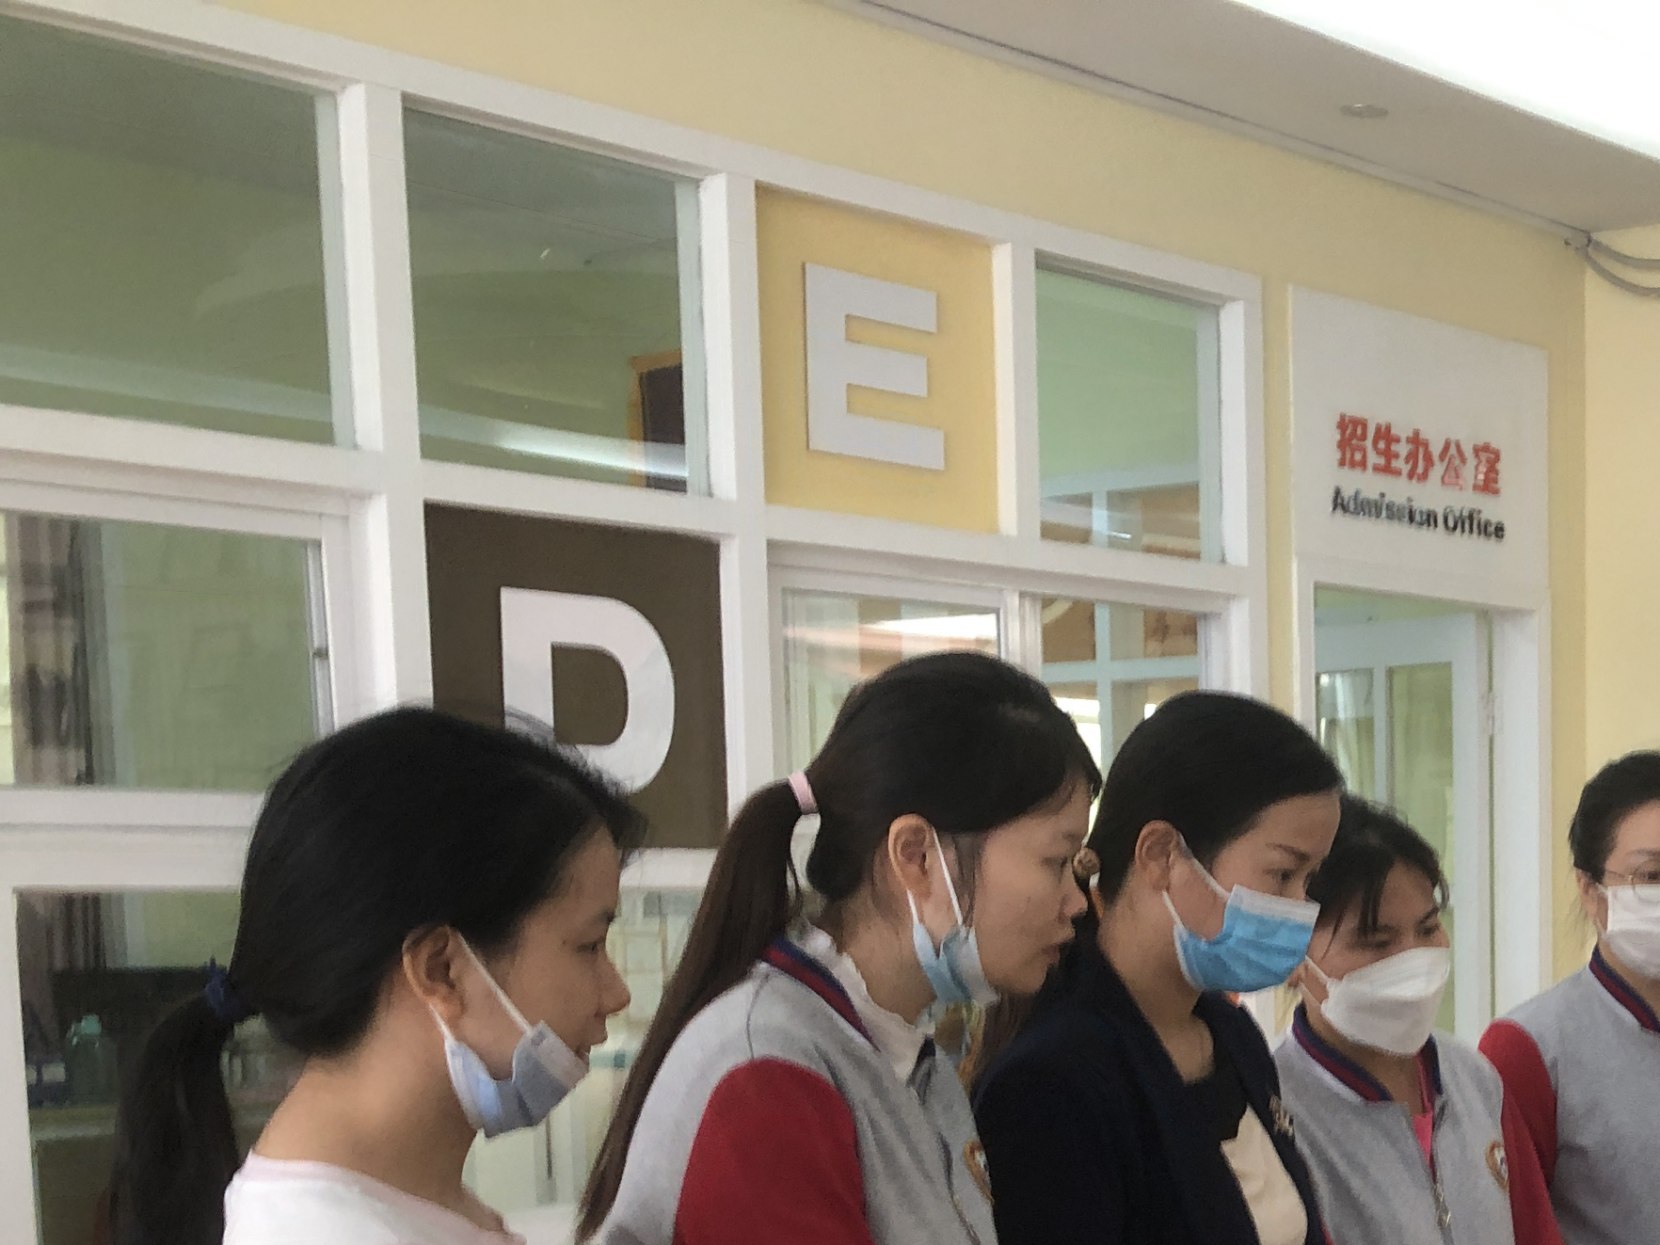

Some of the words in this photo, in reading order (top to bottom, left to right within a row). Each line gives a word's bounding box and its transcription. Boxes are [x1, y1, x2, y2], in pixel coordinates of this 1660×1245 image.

[803, 261, 946, 472] E
[1336, 412, 1502, 497] 招生办公室
[1331, 485, 1439, 531] Admission
[1442, 505, 1506, 542] Office
